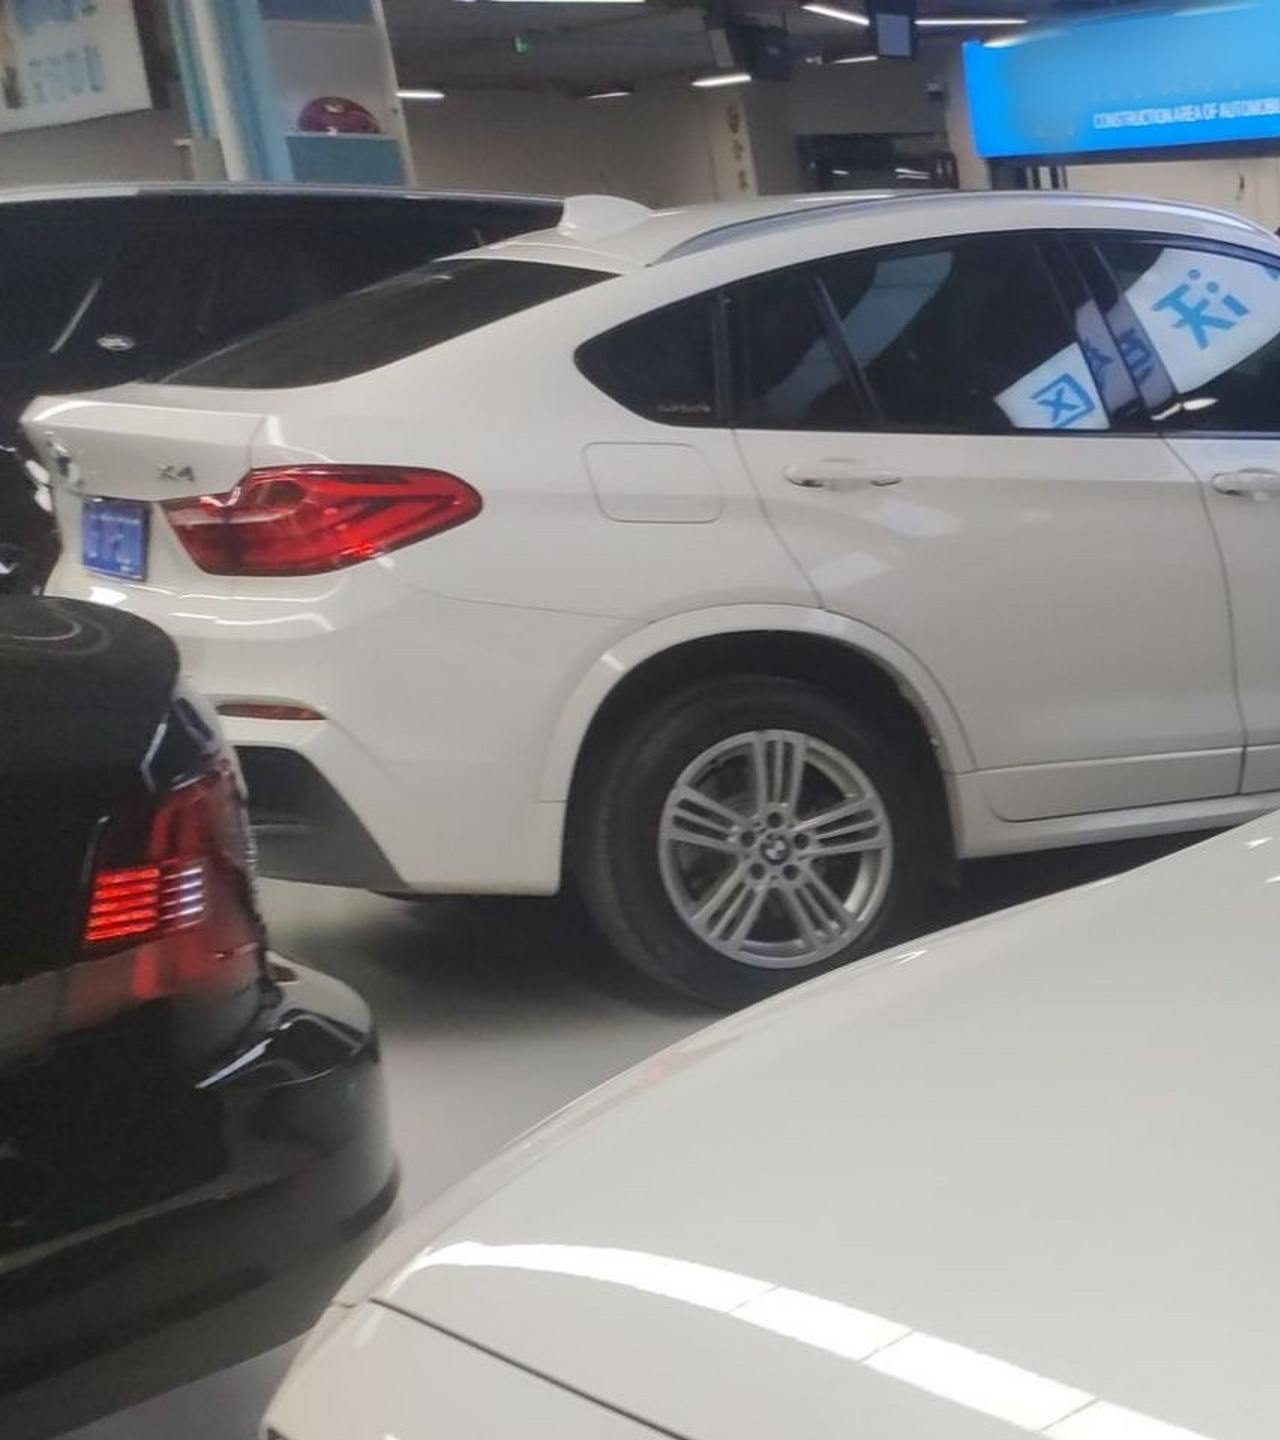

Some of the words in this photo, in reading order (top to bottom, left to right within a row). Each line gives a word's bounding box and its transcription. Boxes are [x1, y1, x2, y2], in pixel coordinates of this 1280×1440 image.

[1093, 108, 1173, 130] CONSTRUCTION
[1173, 104, 1201, 122] AREA
[1202, 102, 1218, 120] OF
